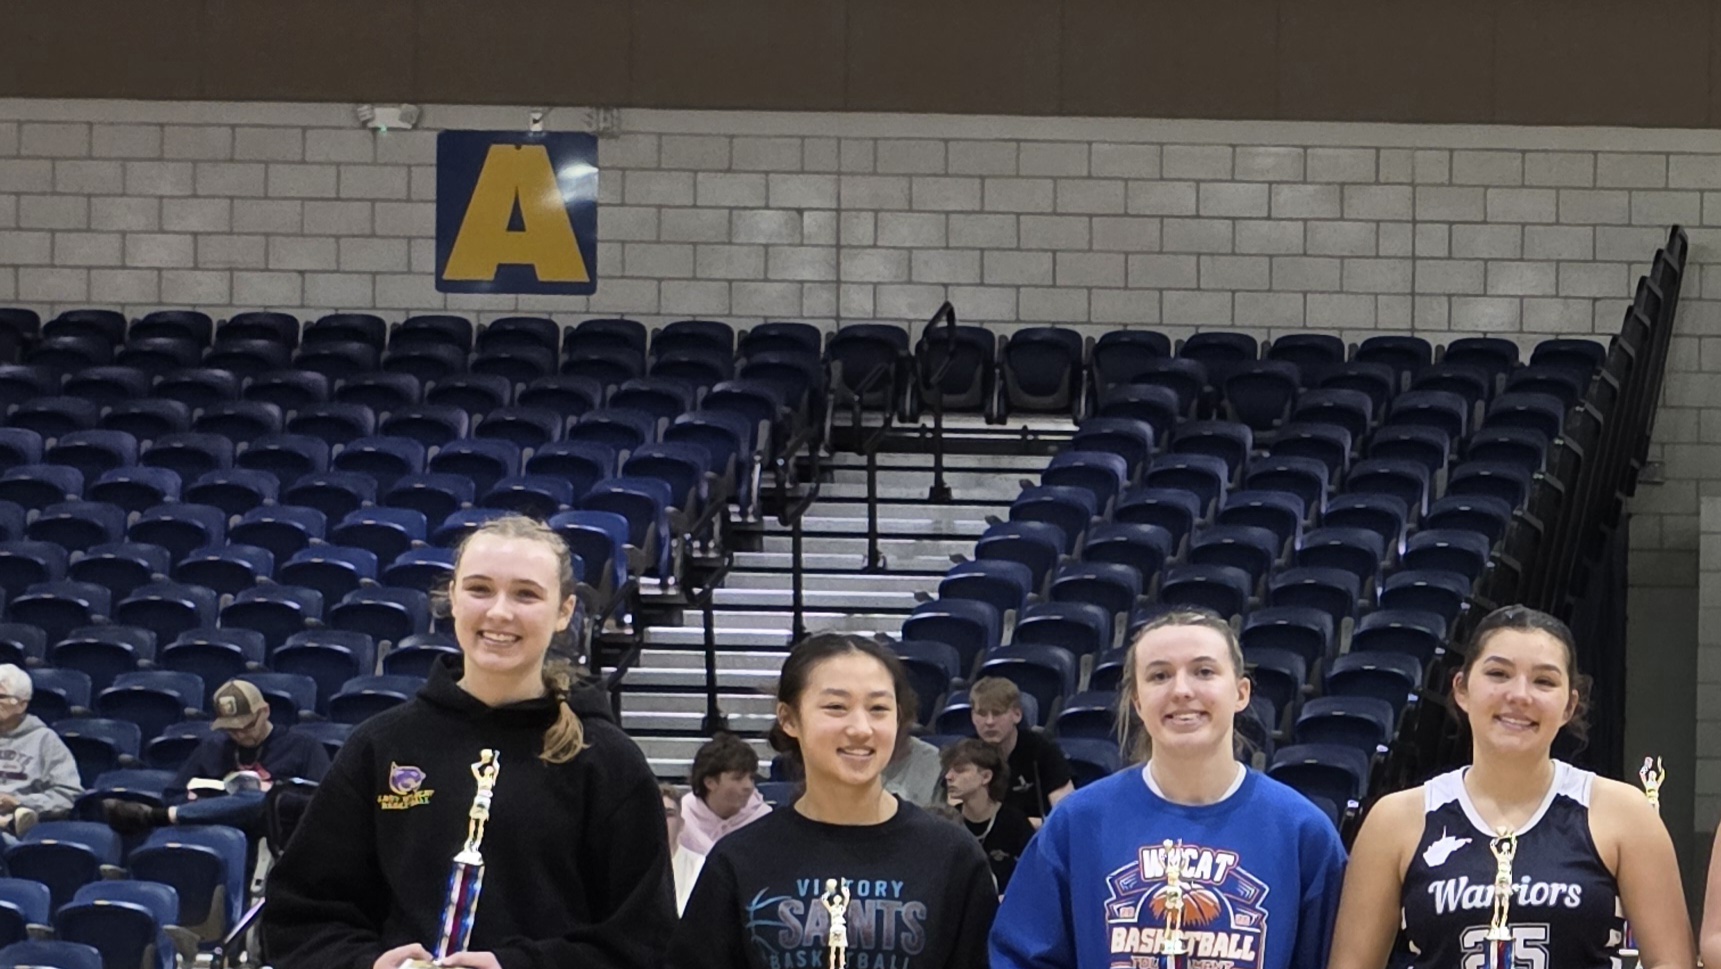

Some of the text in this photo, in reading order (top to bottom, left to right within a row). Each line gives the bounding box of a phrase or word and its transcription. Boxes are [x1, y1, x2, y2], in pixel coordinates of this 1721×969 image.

[442, 143, 591, 283] A
[796, 878, 904, 898] VITORY
[1428, 875, 1583, 915] Wariors
[778, 898, 927, 956] SANTS
[1110, 926, 1257, 962] BASKTBALL
